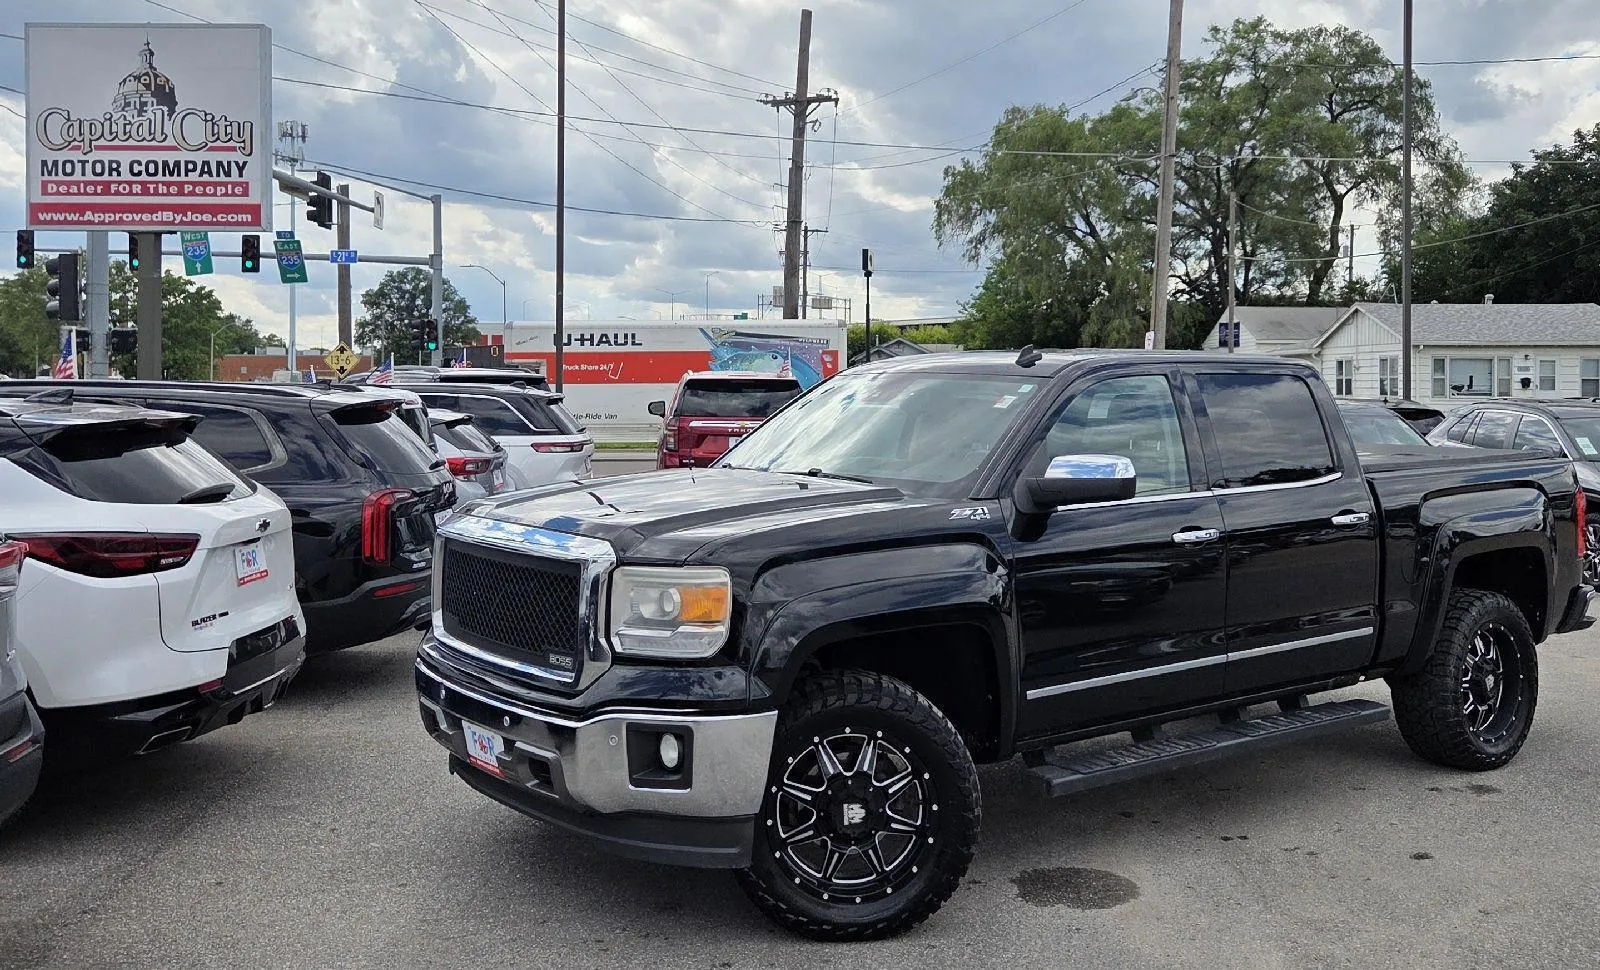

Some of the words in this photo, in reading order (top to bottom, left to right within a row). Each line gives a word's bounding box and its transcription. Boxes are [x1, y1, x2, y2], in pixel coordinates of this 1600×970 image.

[36, 107, 168, 155] Capital
[172, 108, 253, 156] City
[41, 160, 122, 177] MOTOR
[129, 160, 248, 178] COMPANY
[47, 183, 103, 193] Dealer
[110, 184, 142, 193] FOR
[147, 183, 178, 194] The
[184, 184, 243, 196] People
[38, 211, 252, 223] www.ApprovedByJoe.com
[187, 246, 206, 256] 235
[282, 256, 300, 264] 235
[553, 333, 642, 346] U-HAUL
[549, 654, 573, 669] BOSS
